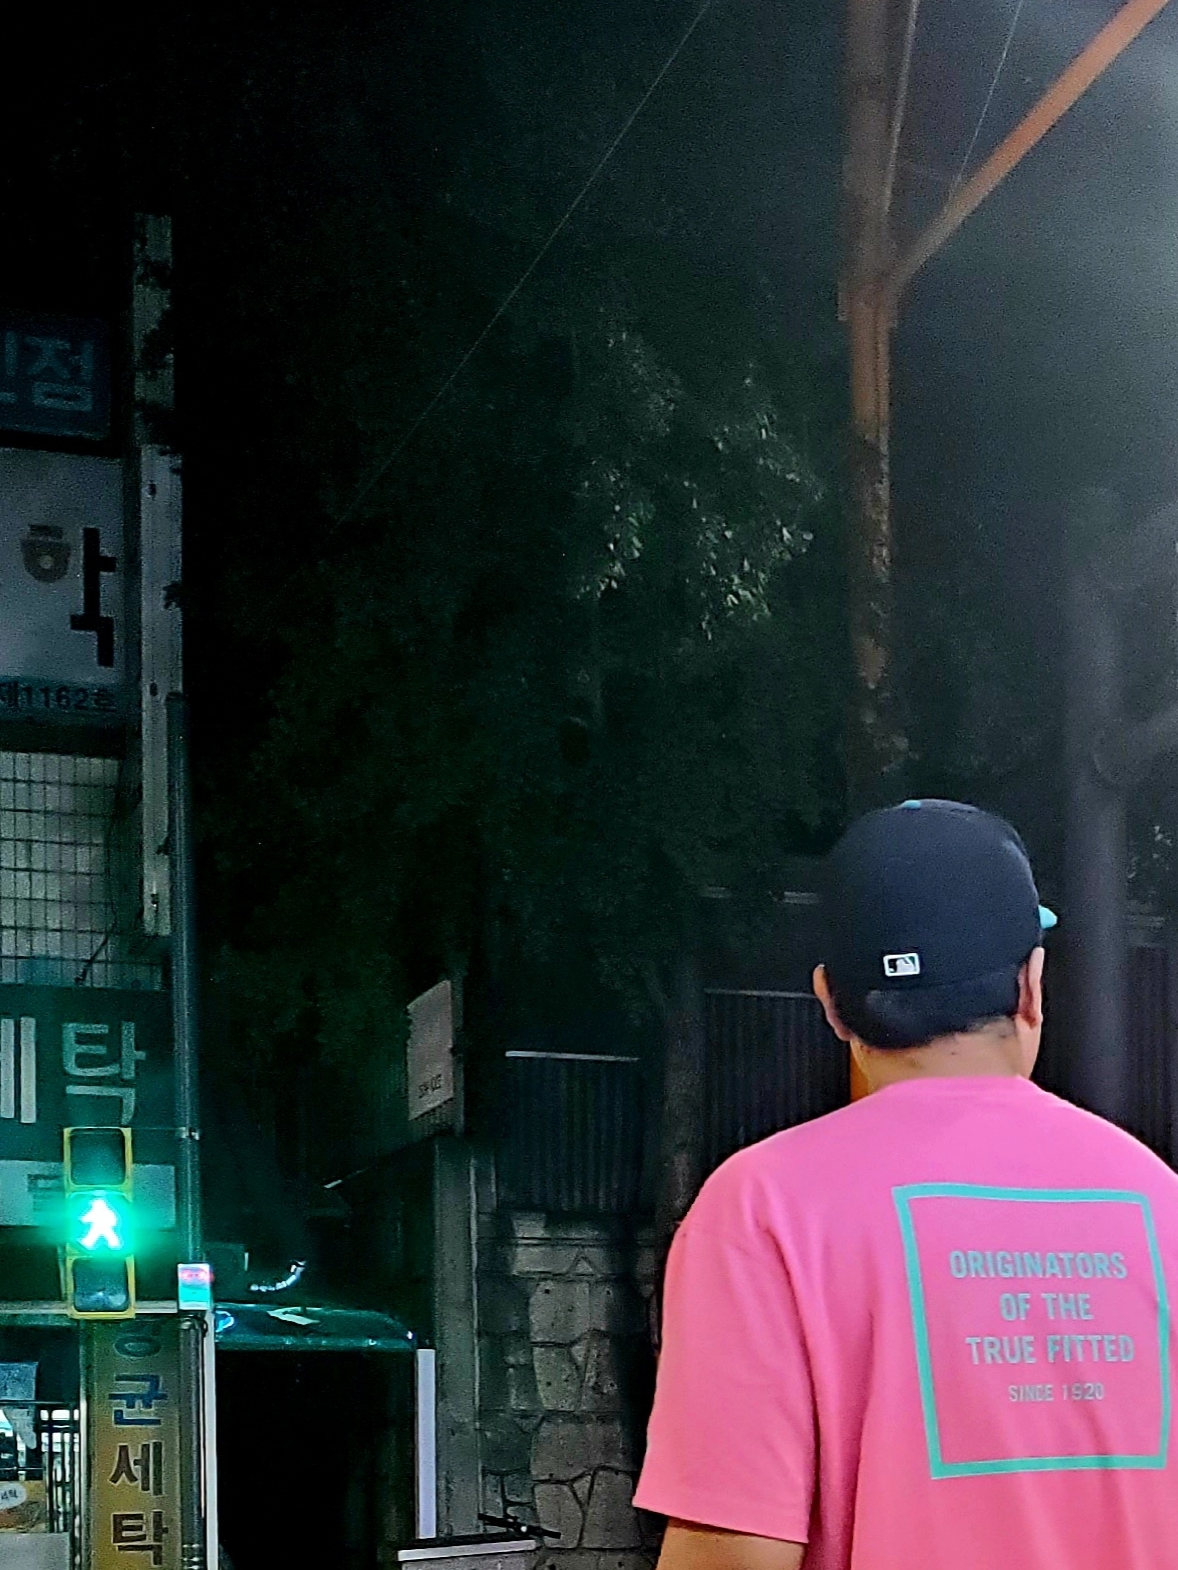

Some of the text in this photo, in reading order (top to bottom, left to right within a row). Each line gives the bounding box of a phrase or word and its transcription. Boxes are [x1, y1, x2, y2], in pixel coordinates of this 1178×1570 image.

[949, 1250, 1127, 1279] ORIGINATORS
[999, 1293, 1094, 1321] OF THE
[965, 1334, 1135, 1365] TRUE FITTED
[1008, 1382, 1105, 1403] SINCE 1920
